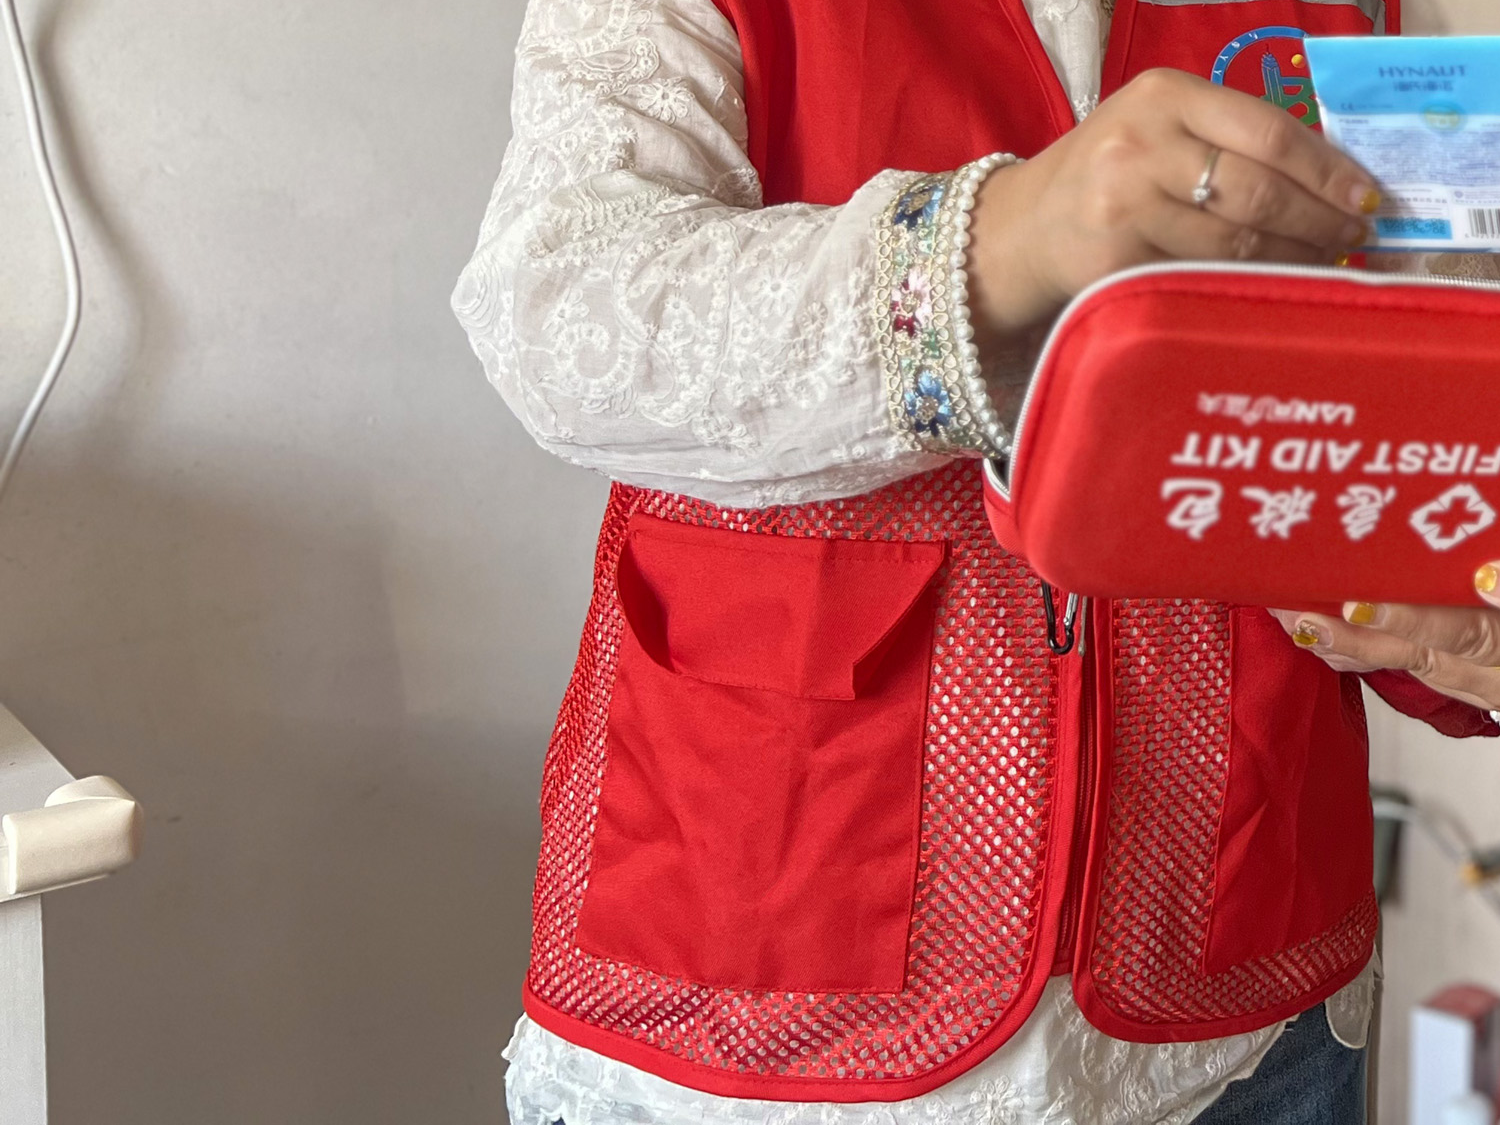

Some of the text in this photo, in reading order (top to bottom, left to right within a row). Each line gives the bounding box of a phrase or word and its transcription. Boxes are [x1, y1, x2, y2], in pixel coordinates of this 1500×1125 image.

[1378, 64, 1467, 78] HYNAUT
[1169, 431, 1262, 470] KIT
[1269, 437, 1362, 473] AID
[1160, 477, 1397, 542] 急救包
